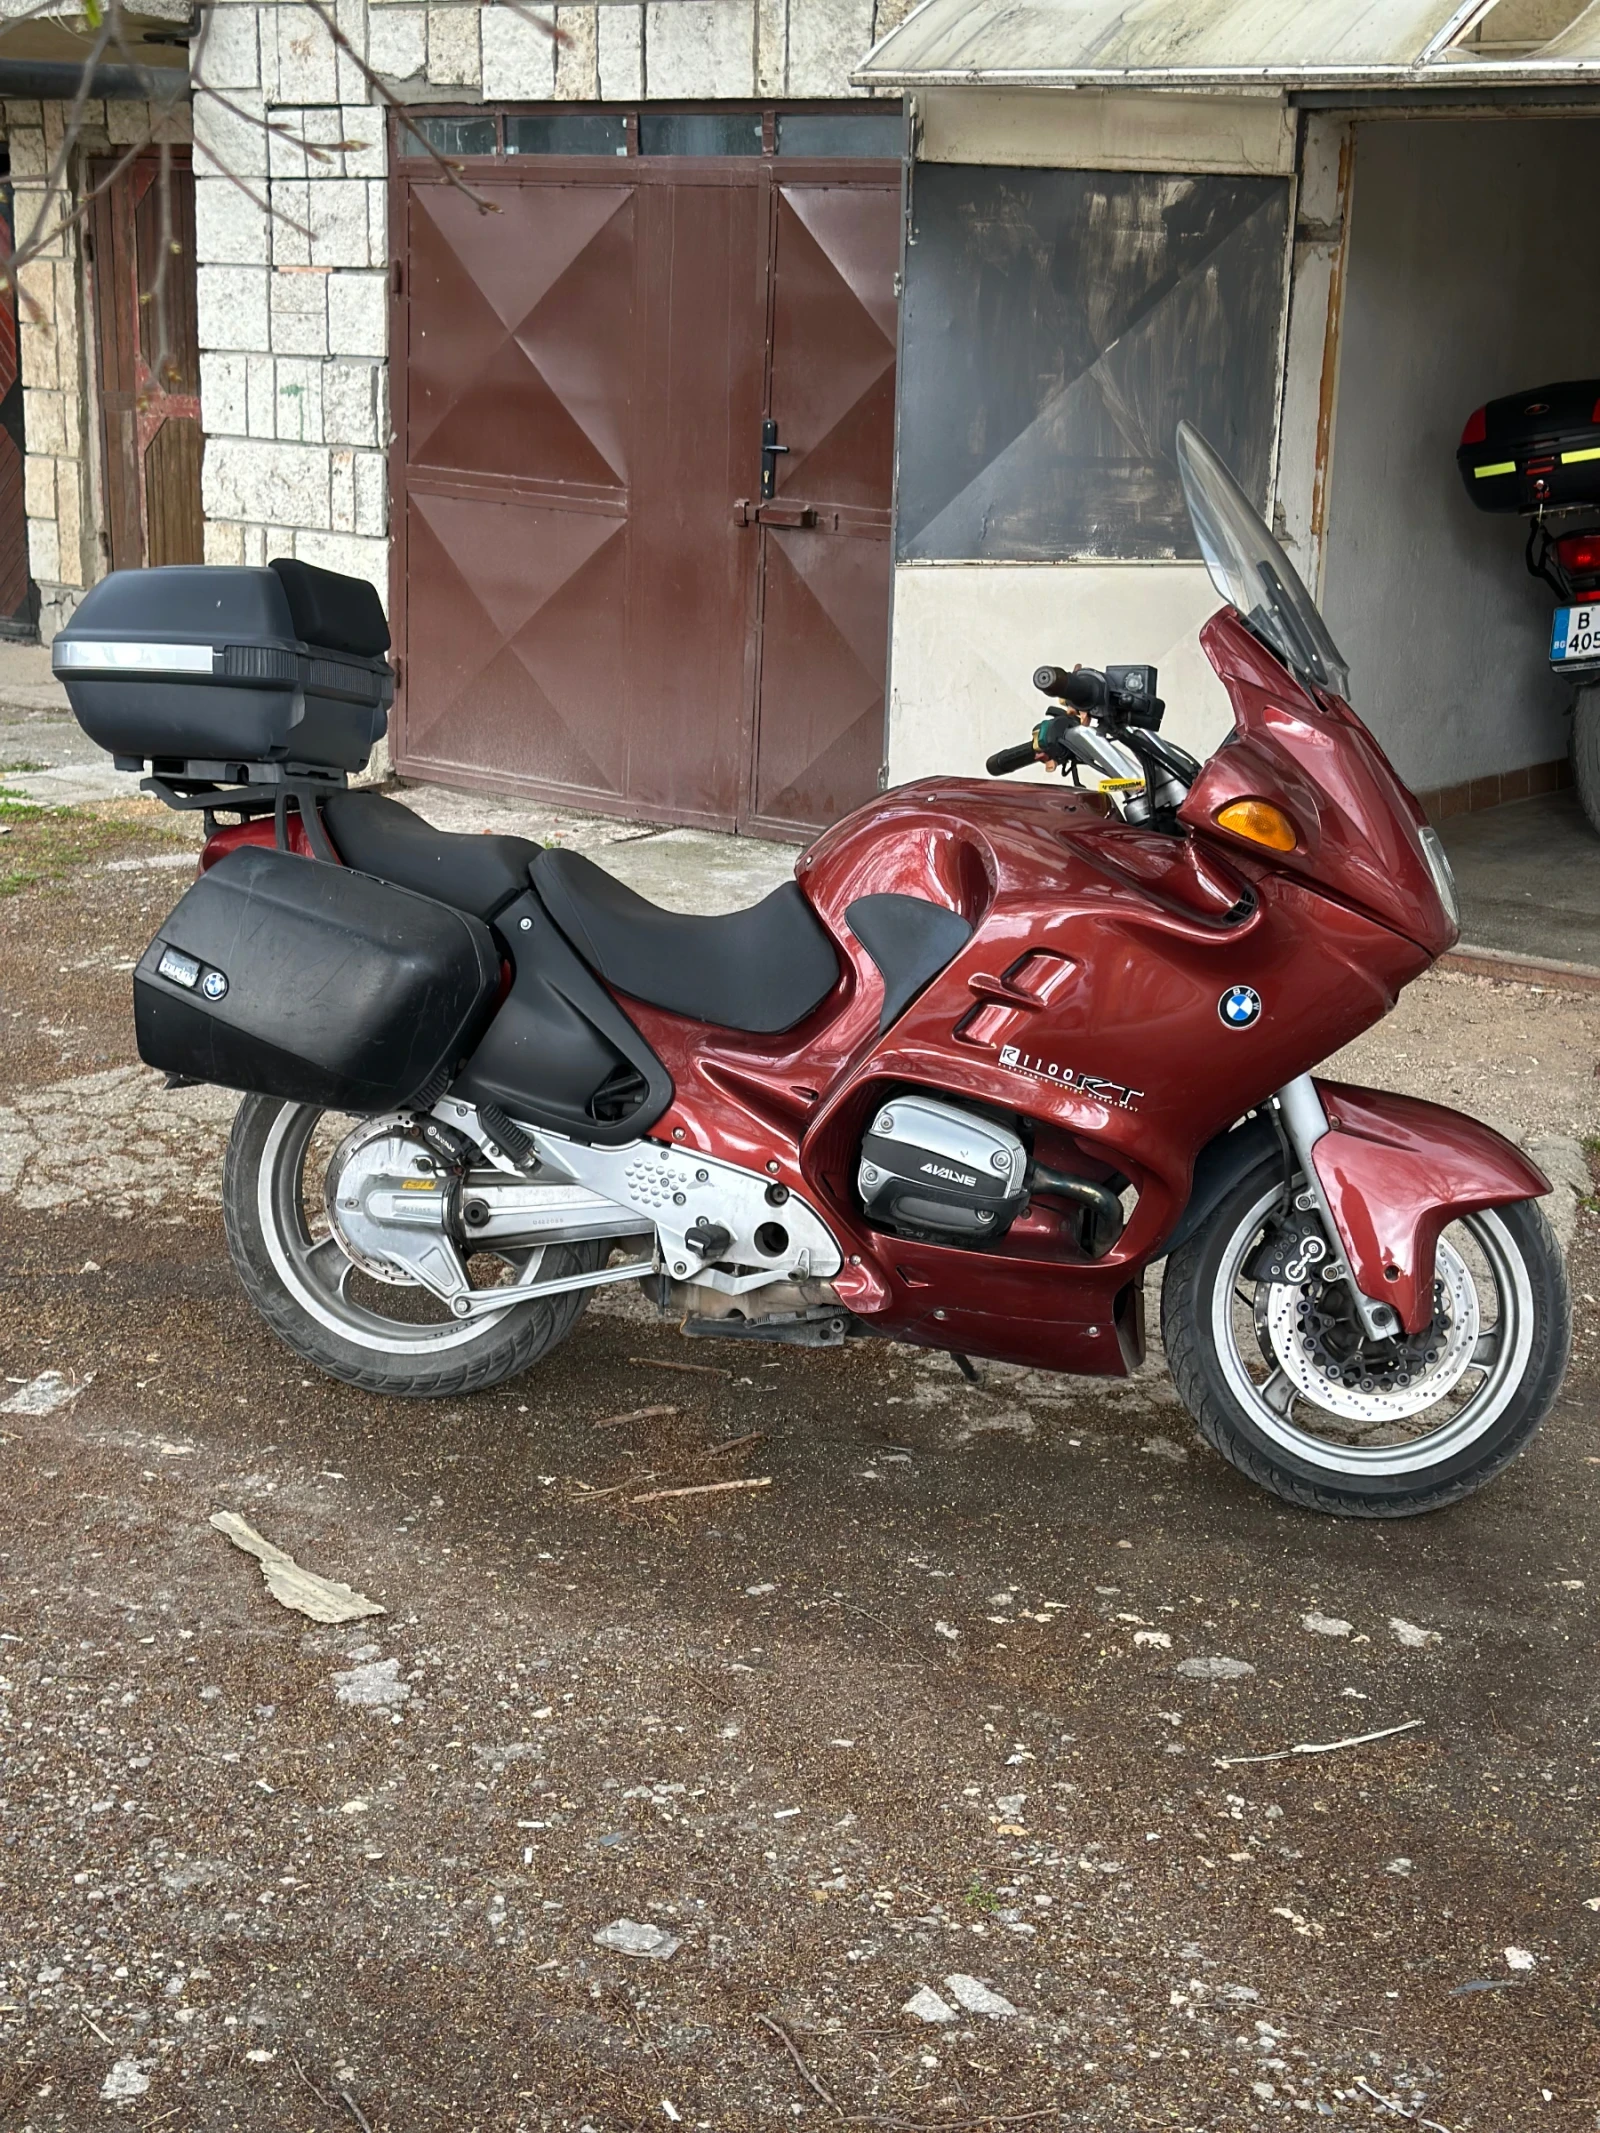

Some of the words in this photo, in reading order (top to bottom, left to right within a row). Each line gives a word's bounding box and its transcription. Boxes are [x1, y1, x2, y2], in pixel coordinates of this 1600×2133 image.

[1577, 612, 1590, 630] B
[1553, 641, 1566, 649] BG
[1233, 987, 1260, 1011] BMW
[1023, 1055, 1073, 1080] 1100
[1076, 1073, 1145, 1105] RT
